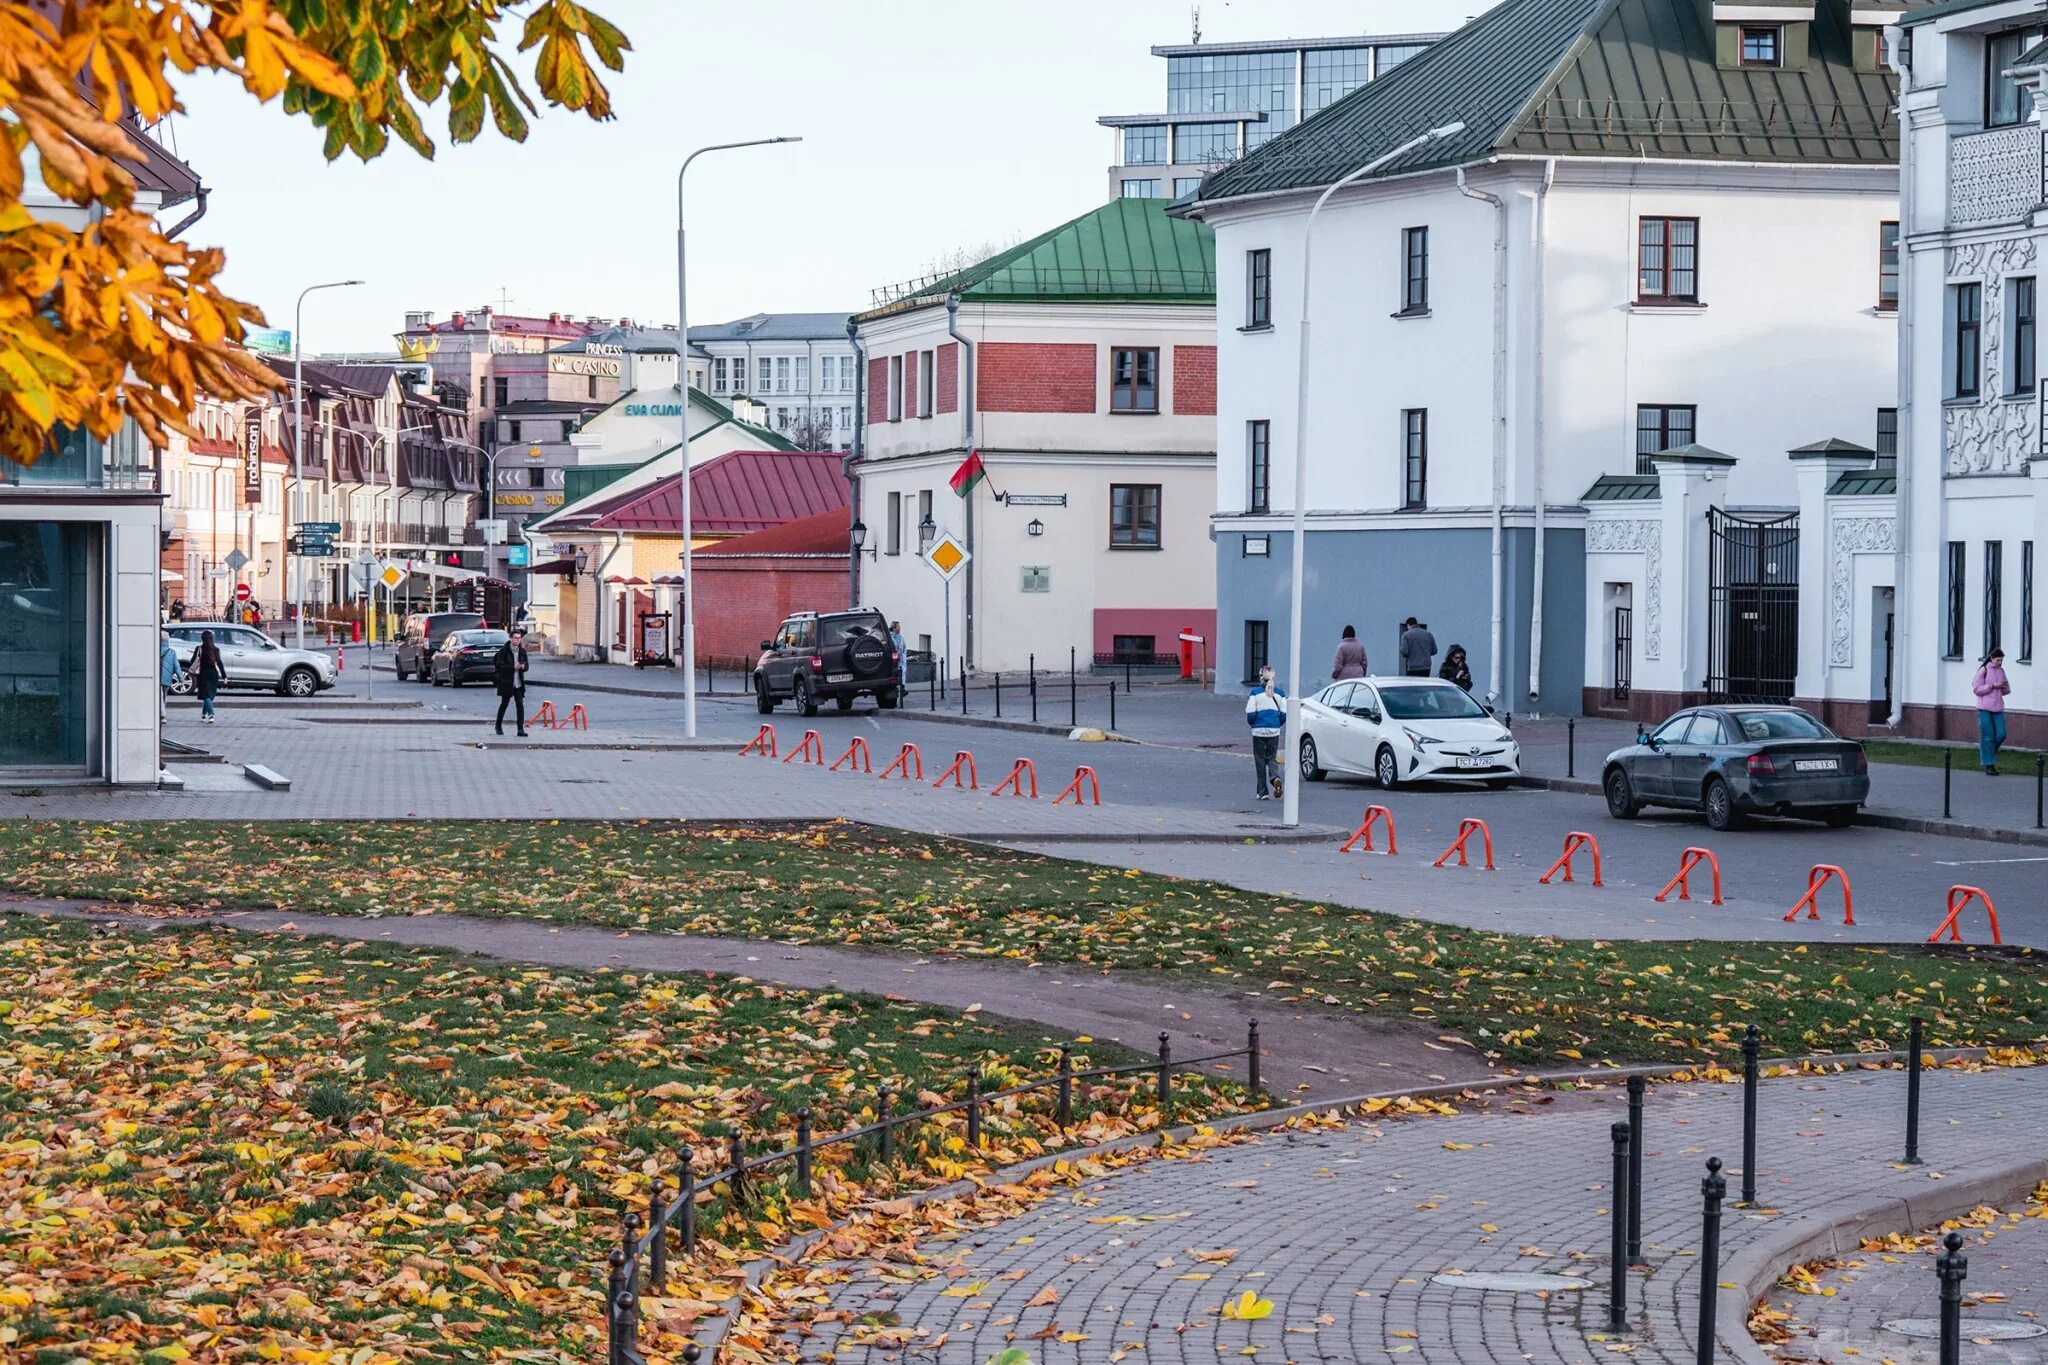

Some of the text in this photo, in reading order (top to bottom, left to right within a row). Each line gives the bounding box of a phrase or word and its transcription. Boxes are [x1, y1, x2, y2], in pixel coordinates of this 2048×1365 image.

[586, 342, 623, 356] PRINCESS
[572, 359, 619, 376] CASINO
[246, 424, 259, 485] robinson
[495, 495, 535, 506] CASINO
[855, 651, 884, 659] PATRIOT
